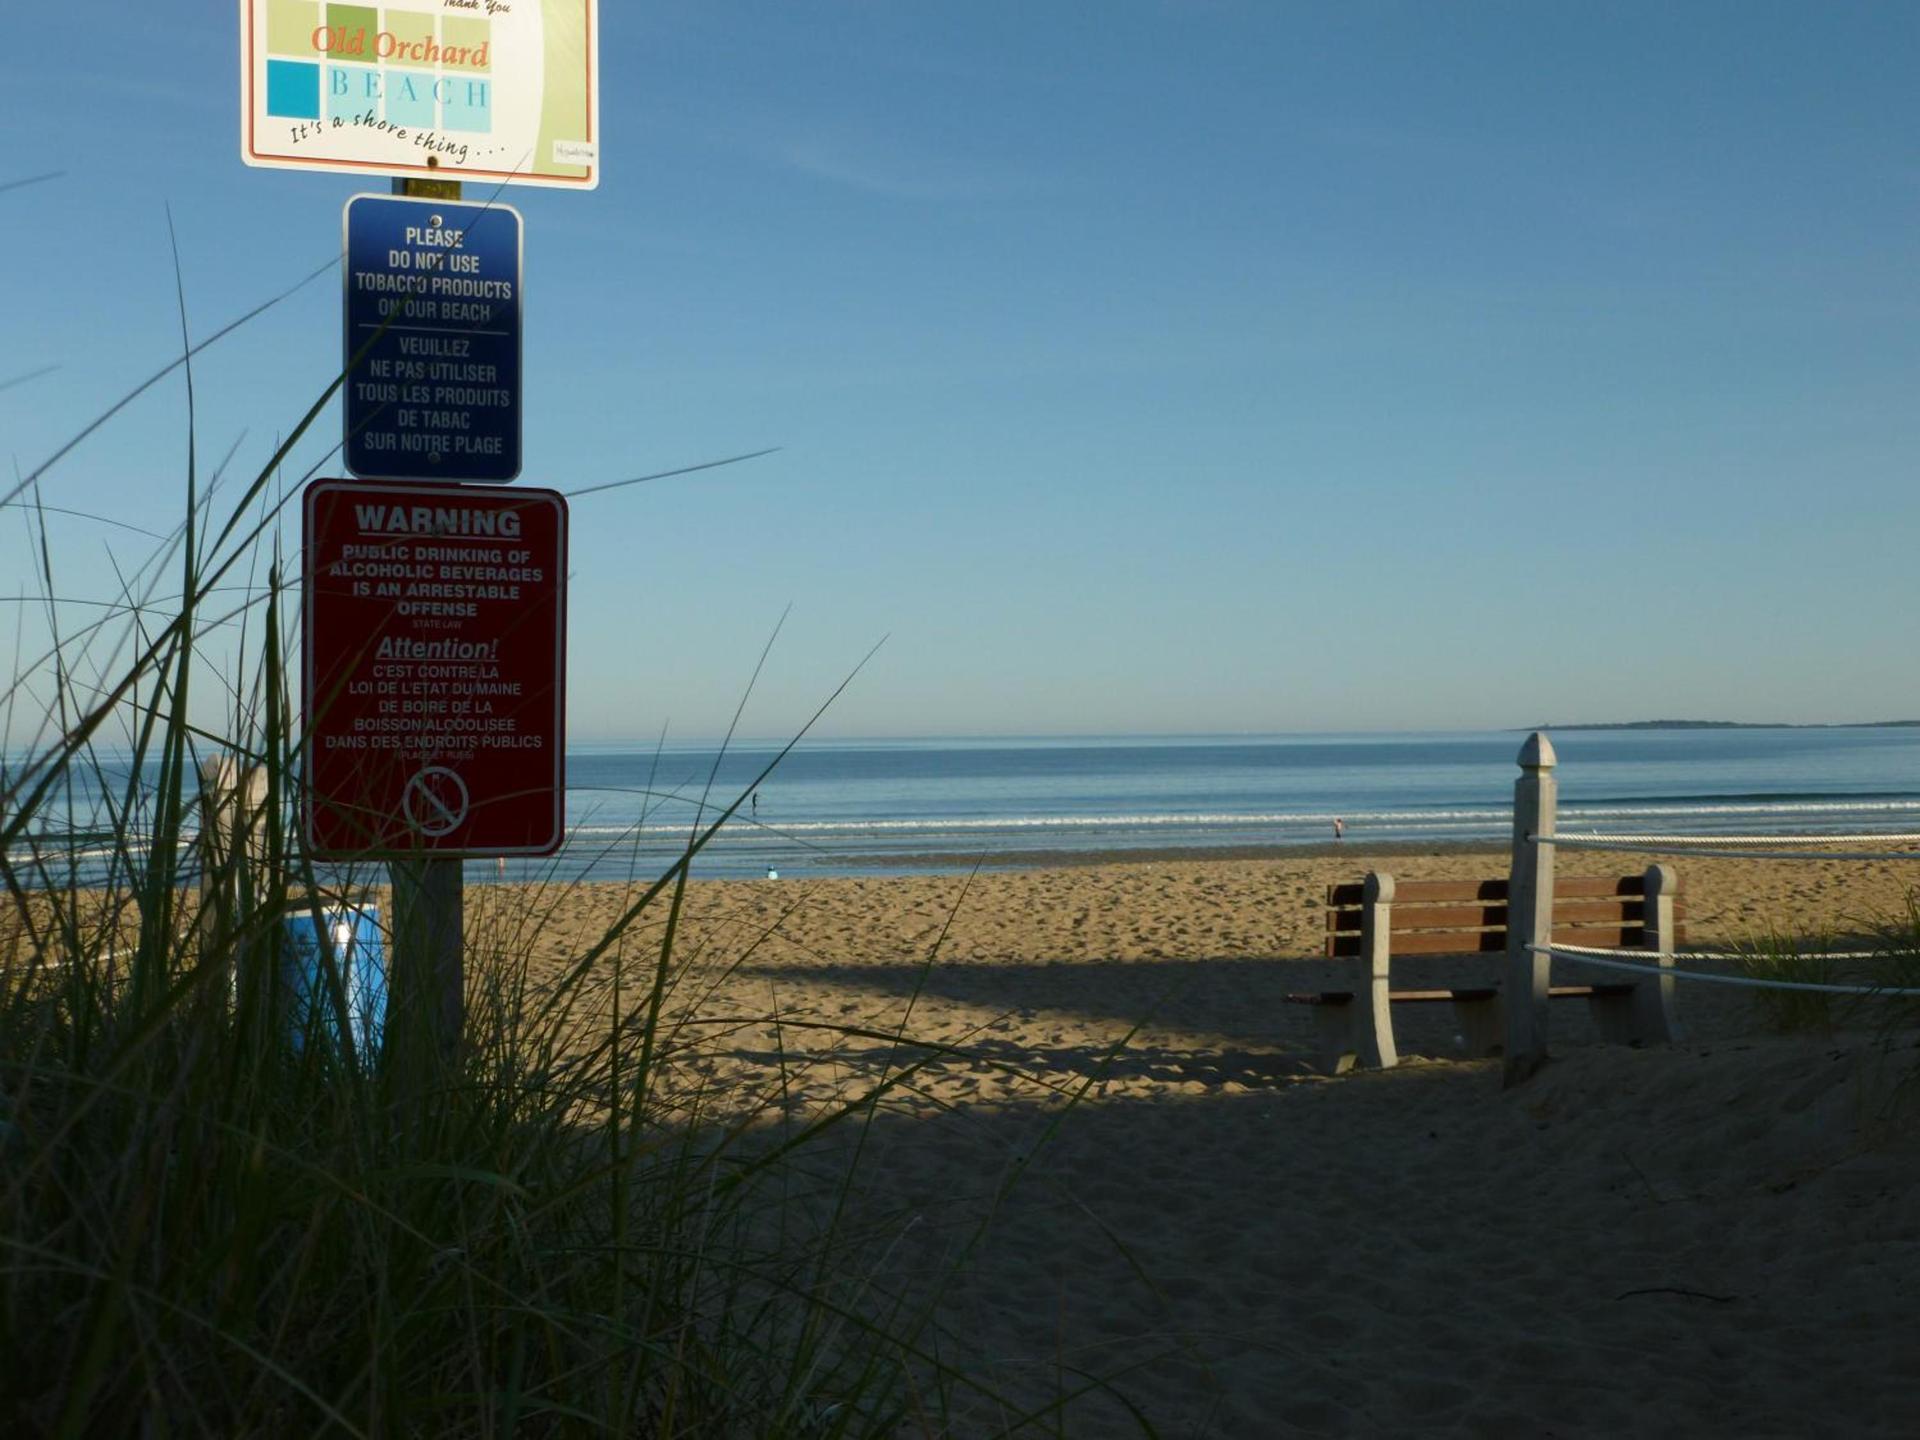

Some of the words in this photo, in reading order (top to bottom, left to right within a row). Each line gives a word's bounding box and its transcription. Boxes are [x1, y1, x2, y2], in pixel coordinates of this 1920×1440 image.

[485, 0, 511, 15] You
[312, 26, 365, 54] Old
[373, 31, 489, 67] Orchard
[331, 70, 487, 107] BEACH
[291, 120, 322, 145] It's
[332, 115, 344, 129] a
[353, 109, 407, 140] shore
[406, 227, 463, 248] PLEASE
[389, 250, 410, 268] DO
[415, 252, 444, 271] NOT
[450, 256, 480, 273] USE
[356, 272, 427, 294] TOBACCO
[432, 277, 512, 300] PRODUCTS
[378, 298, 400, 317] ON
[405, 300, 437, 319] OUR
[442, 302, 490, 321] BEACH
[400, 336, 470, 357] VEUILLEZ
[370, 360, 391, 378] NE
[395, 361, 425, 379] PAS
[430, 362, 497, 382] UTILISER
[356, 383, 398, 402] TOUS
[403, 385, 430, 403] LES
[435, 387, 511, 407] PRODUITS
[398, 409, 418, 427] DE
[422, 410, 470, 429] TABAC
[364, 432, 396, 450] SUR
[401, 433, 450, 452] NOTRE
[455, 436, 503, 454] PLAGE
[354, 504, 521, 536] WARNING
[342, 545, 409, 560] PUBLIC
[415, 547, 502, 563] DRINKING
[508, 551, 531, 564] OF
[329, 563, 434, 578] ALCOHOLIC
[440, 566, 543, 582] BEVERAGES
[353, 582, 370, 596] IS
[376, 582, 401, 597] AN
[406, 583, 520, 600] ARRESTABLE
[397, 602, 478, 617] OFFENSE
[412, 619, 441, 629] STATE
[376, 636, 499, 660] Attention!
[373, 665, 414, 678] C'EST
[418, 665, 477, 678] CONTRE
[481, 666, 499, 678] LA
[349, 682, 373, 694] LOI
[378, 682, 397, 694] DE
[452, 683, 472, 695] DU
[476, 683, 521, 695] MAINE
[379, 701, 398, 713] DE
[402, 700, 447, 713] BOIRE
[452, 701, 471, 713] DE
[475, 701, 493, 713] LA
[354, 719, 424, 731] BOISSON
[326, 736, 367, 749] DANS
[371, 736, 401, 749] DES
[405, 736, 478, 749] ENDROITS
[482, 736, 543, 749] PUBLICS
